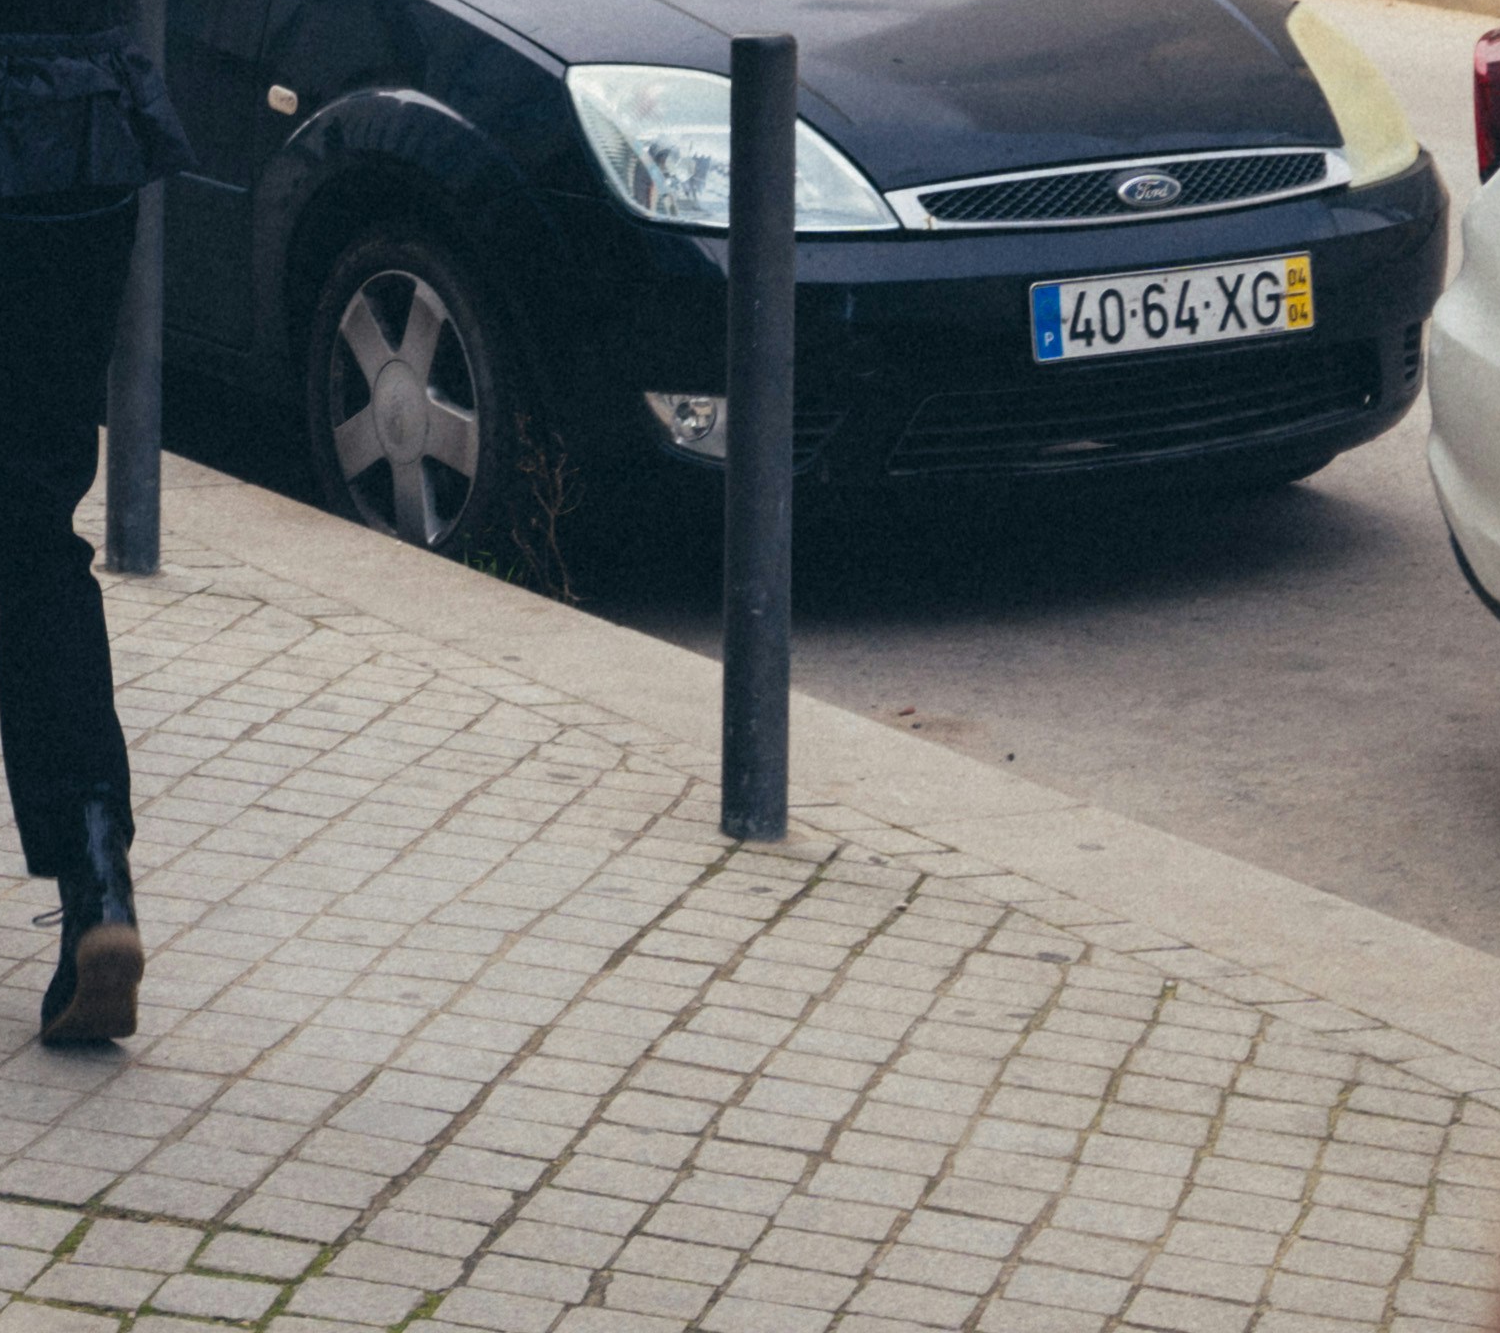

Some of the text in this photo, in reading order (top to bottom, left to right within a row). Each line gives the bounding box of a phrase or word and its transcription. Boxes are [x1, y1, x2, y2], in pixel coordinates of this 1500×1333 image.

[1135, 180, 1169, 201] Ford
[1045, 331, 1055, 347] P
[1287, 267, 1307, 287] 04
[1288, 302, 1309, 323] 04
